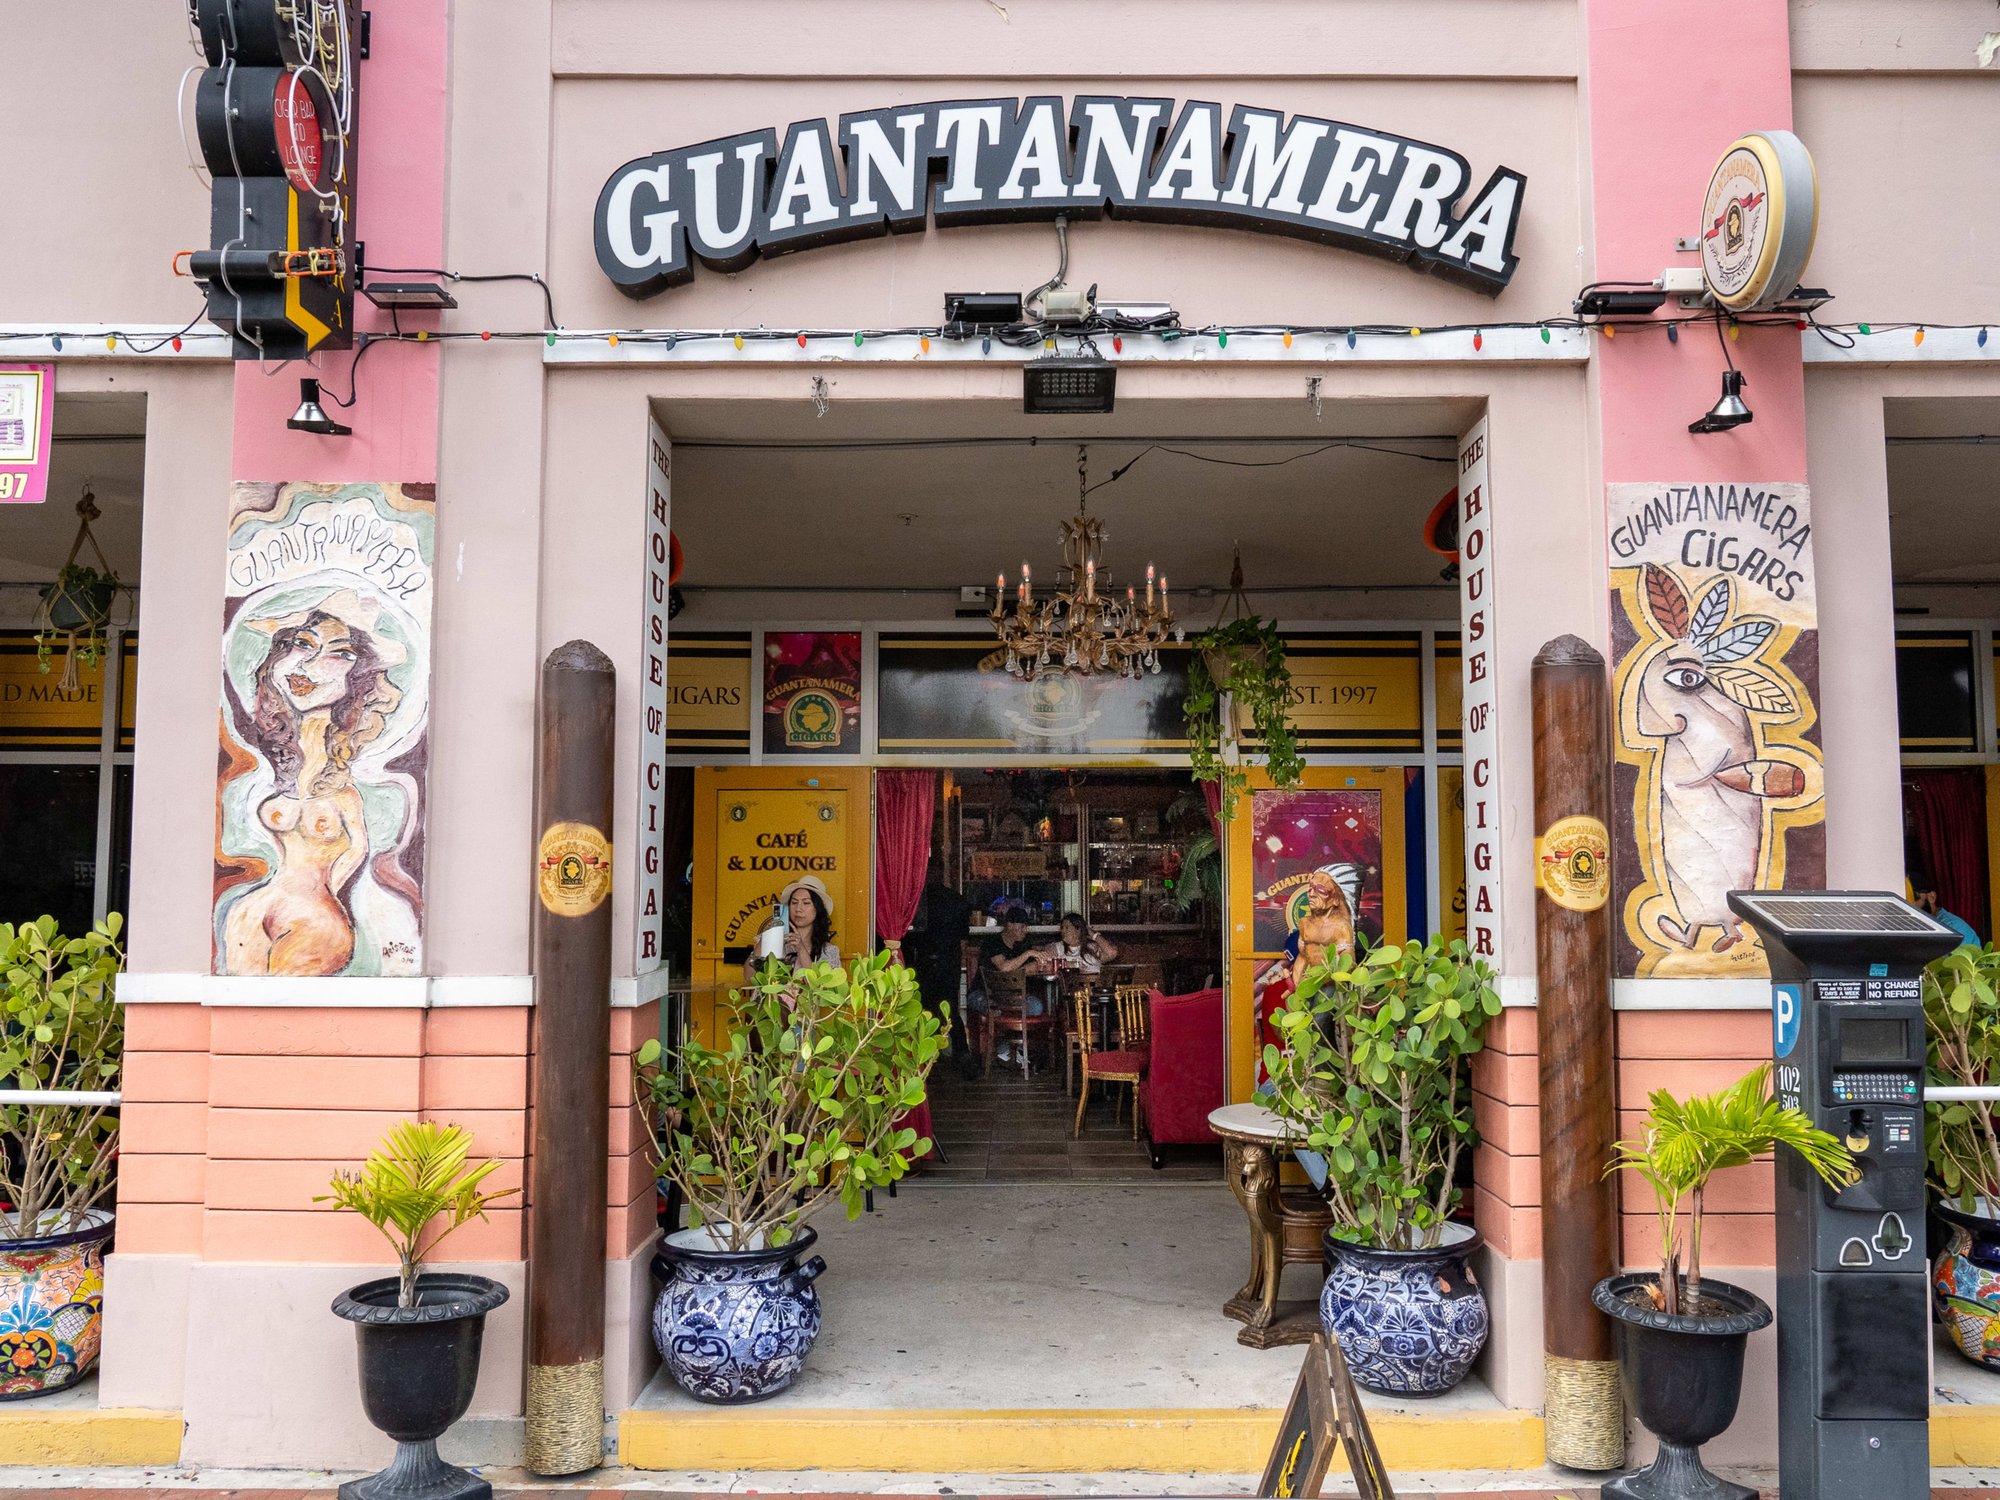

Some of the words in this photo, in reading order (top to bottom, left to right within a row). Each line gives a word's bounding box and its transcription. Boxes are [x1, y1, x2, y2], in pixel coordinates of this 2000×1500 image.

[275, 98, 298, 118] CIGR
[285, 146, 317, 164] LONGE
[605, 101, 1519, 272] GUANTANAMERA
[652, 438, 670, 480] THE
[1460, 434, 1484, 474] THE
[1611, 484, 1811, 560] GUANTANAMERA
[649, 487, 667, 687] HOUSE
[1464, 484, 1486, 684] HOUSE
[28, 684, 98, 702] MADE
[1330, 686, 1377, 705] 1997
[647, 706, 662, 735] OF
[1470, 702, 1489, 733] OF
[756, 829, 808, 848] CAFÉ
[642, 763, 660, 958] CIGAR
[727, 856, 746, 871] &
[750, 856, 837, 871] LOUNGE
[1473, 758, 1495, 956] CIGAR
[1868, 982, 1881, 990] NO
[1884, 981, 1919, 989] CHANGE
[1884, 990, 1918, 998] REFUND
[1777, 991, 1793, 1043] P
[1778, 1065, 1800, 1092] 102
[1782, 1094, 1800, 1110] 503
